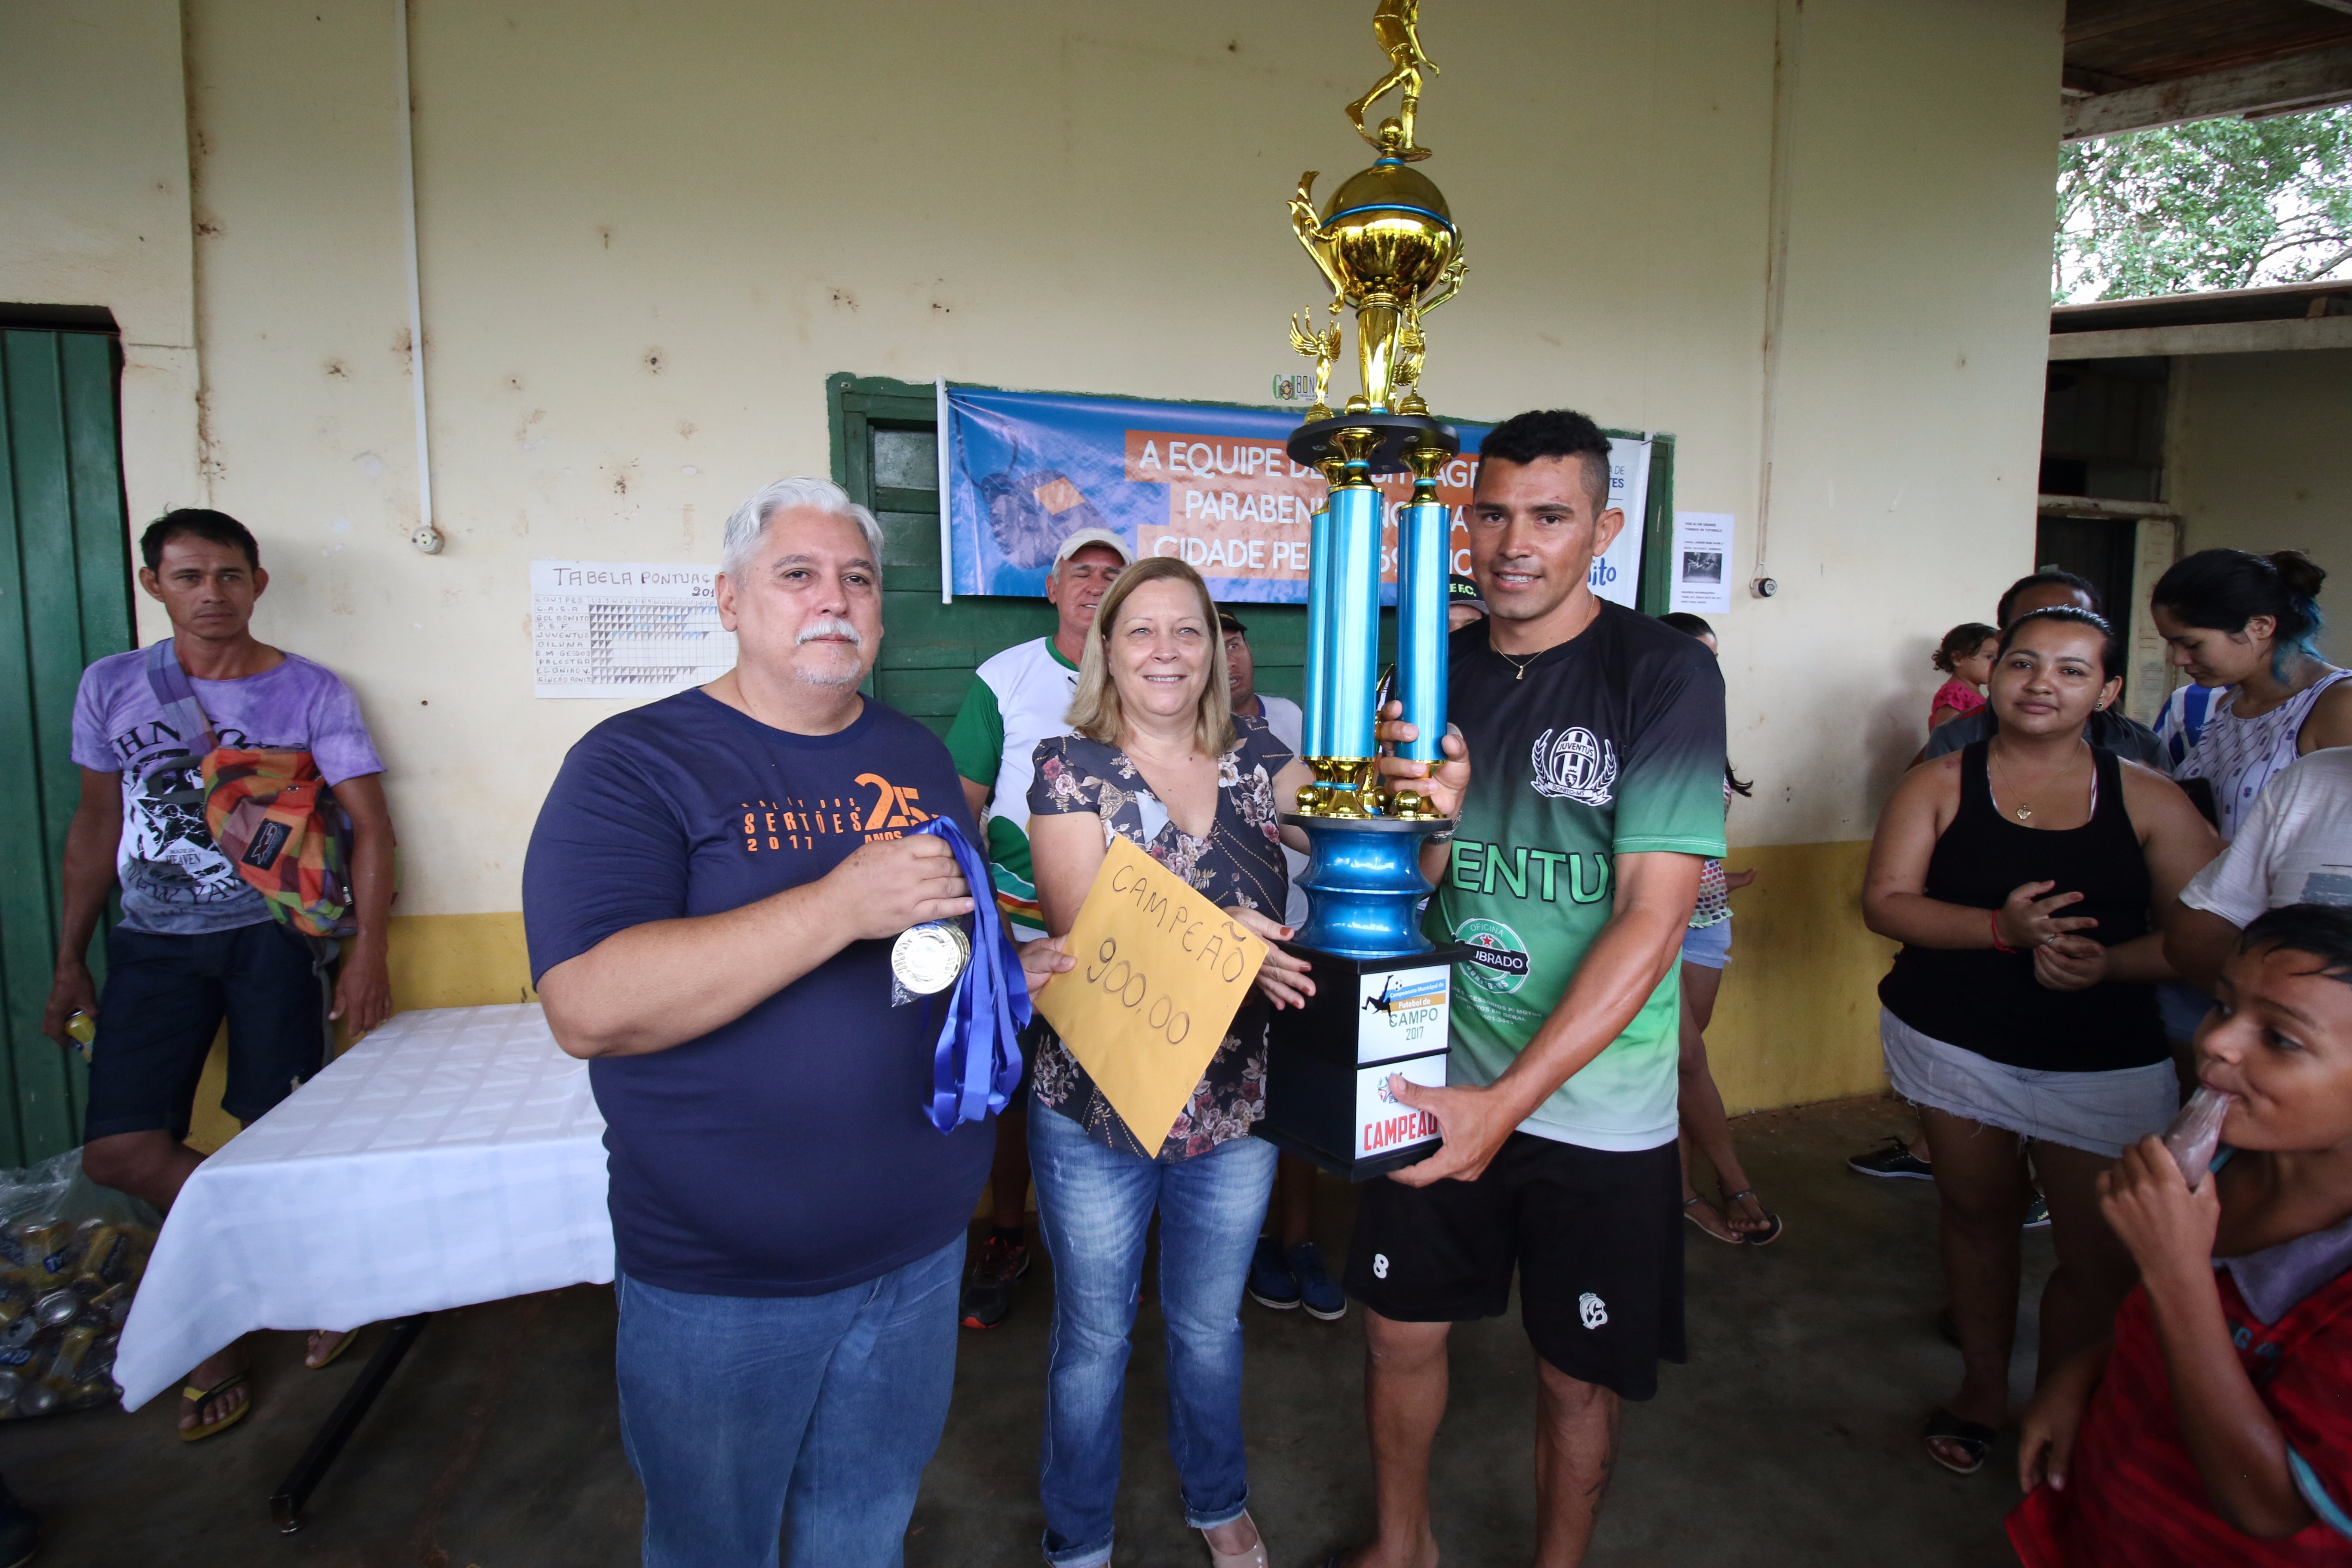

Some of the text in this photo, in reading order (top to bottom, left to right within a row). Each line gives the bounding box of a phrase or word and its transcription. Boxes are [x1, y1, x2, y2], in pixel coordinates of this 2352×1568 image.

[1139, 440, 1161, 469] A
[1169, 441, 1282, 479] EQUIPE
[1614, 466, 1625, 475] DE
[1185, 490, 1328, 524] PARABEN
[1153, 535, 1265, 569] CIDADE
[553, 567, 711, 586] TABELA PONTUAÇ
[692, 586, 715, 597] 201
[1458, 583, 1476, 597] F.C.
[1558, 742, 1594, 757] JUVENTUS
[1552, 784, 1585, 796] BONITO-MS
[820, 797, 855, 808] DOS
[744, 810, 862, 835] SERTÕES
[747, 835, 812, 851] 2017
[166, 853, 201, 865] HEAVEN
[1451, 838, 1610, 904] ENTU
[1112, 865, 1247, 983] CAMPEÃO
[1470, 923, 1504, 937] OFICINA
[1474, 950, 1523, 969] IBRADO
[1087, 937, 1190, 1044] 900,00
[1390, 988, 1417, 998] Campeonato
[1418, 983, 1438, 992] Municipal
[1398, 999, 1422, 1009] Futebol
[1389, 1008, 1438, 1028] CAMPO
[1503, 1013, 1526, 1021] GERAL
[1406, 1026, 1424, 1041] 2017
